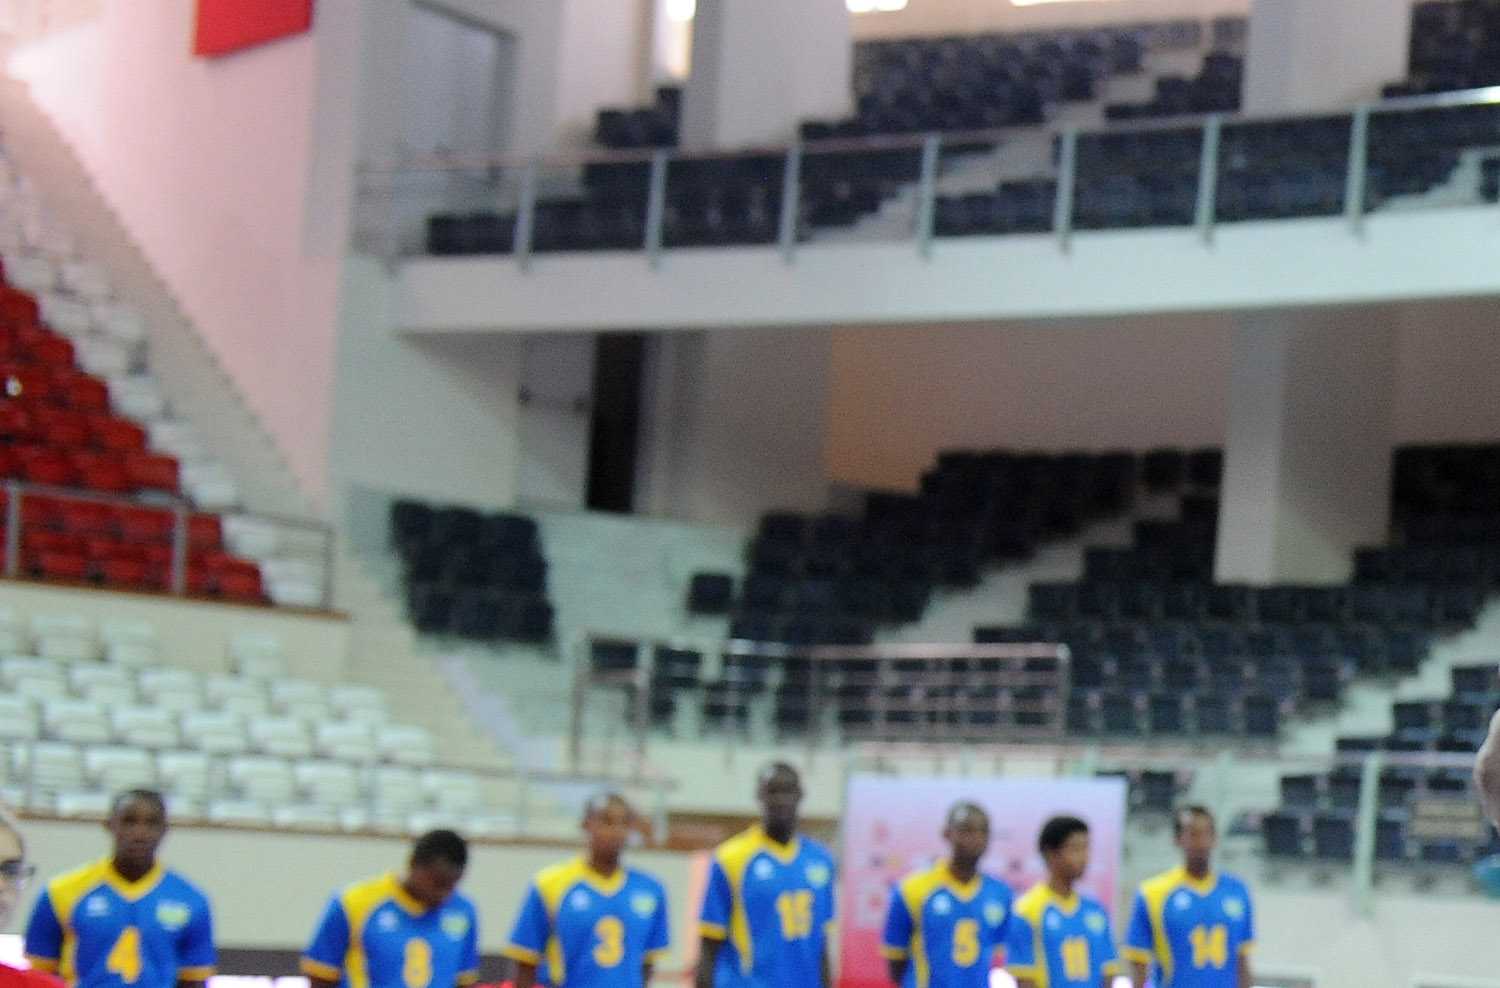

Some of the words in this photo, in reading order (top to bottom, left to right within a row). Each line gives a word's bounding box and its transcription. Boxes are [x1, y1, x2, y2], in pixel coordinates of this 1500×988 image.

[106, 925, 141, 984] 4
[593, 915, 624, 968] 3
[953, 918, 979, 967] 5
[1190, 924, 1227, 970] 14
